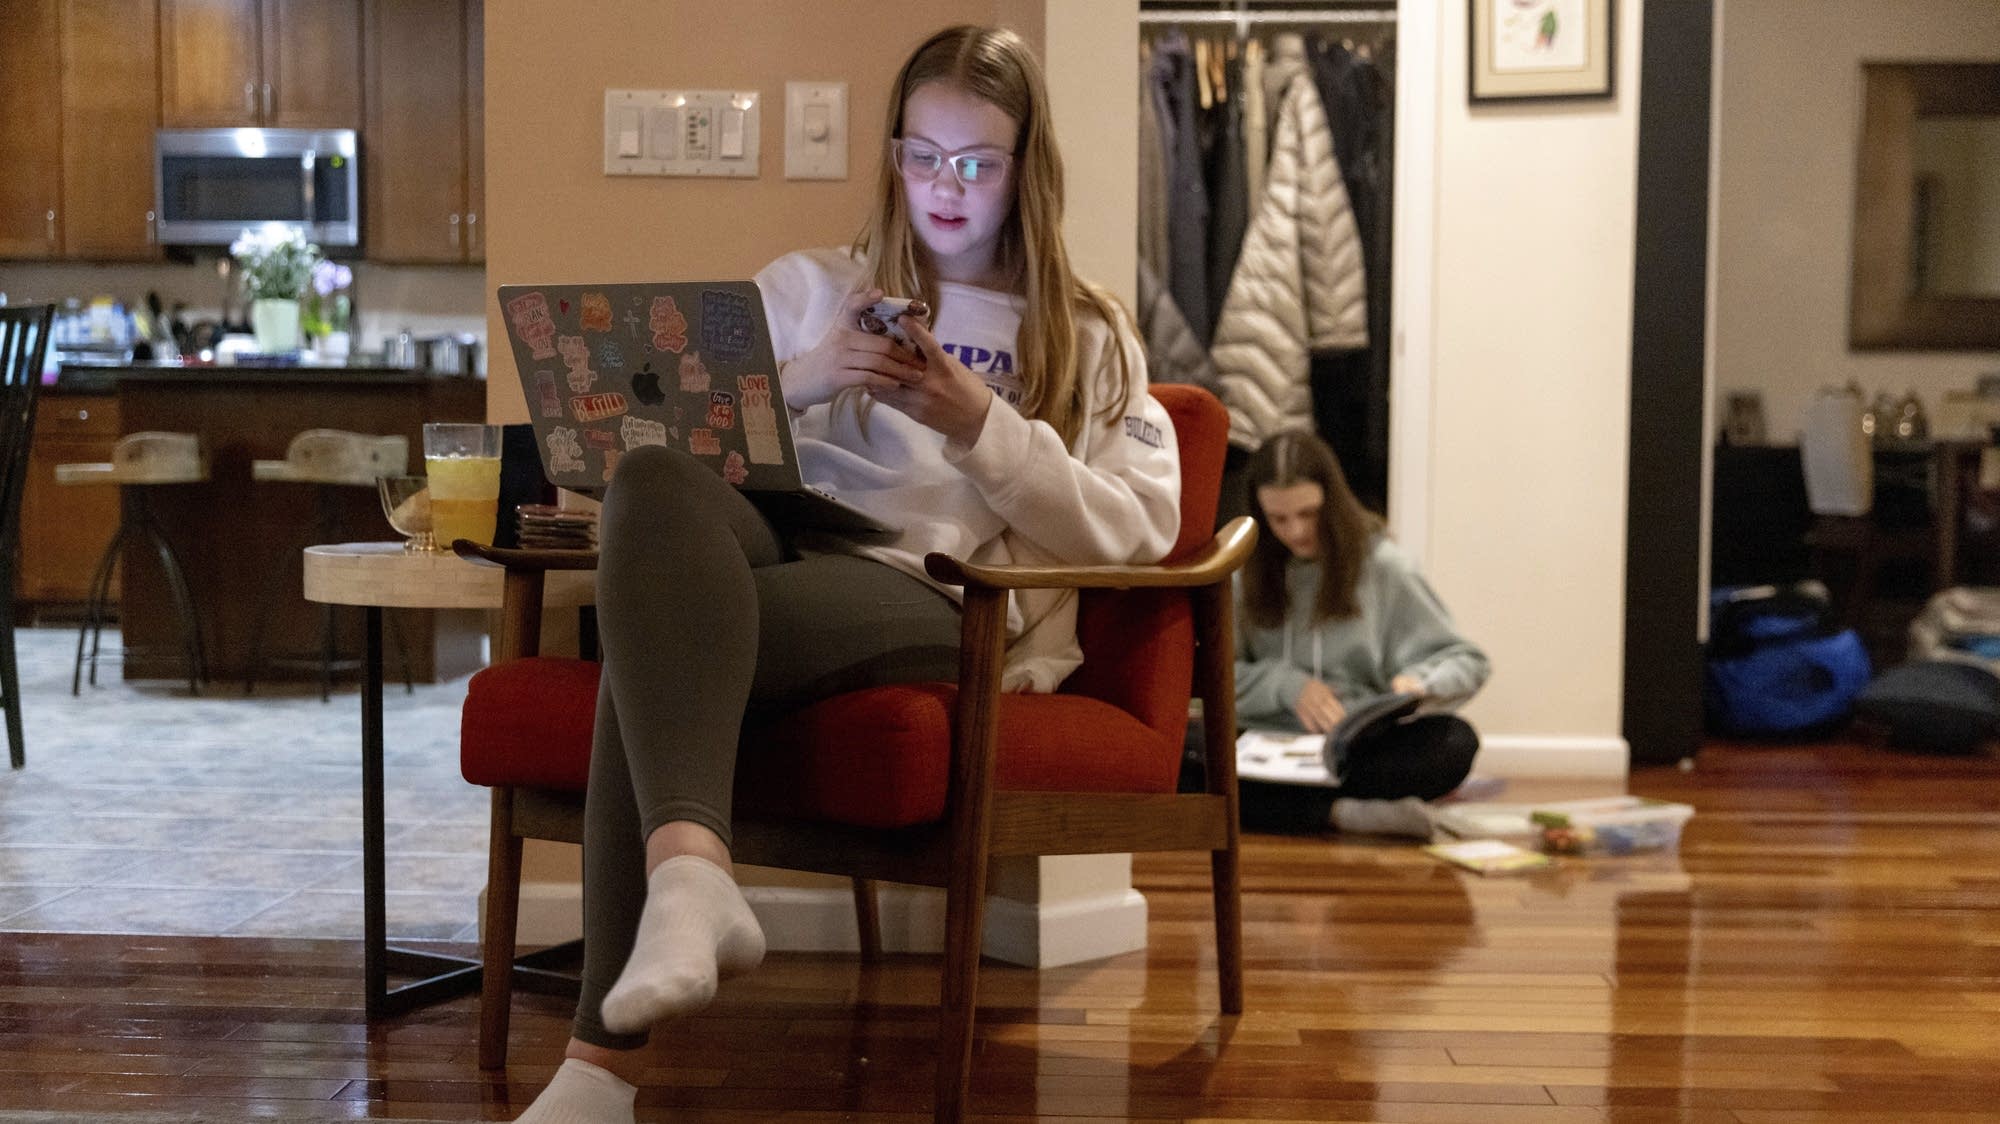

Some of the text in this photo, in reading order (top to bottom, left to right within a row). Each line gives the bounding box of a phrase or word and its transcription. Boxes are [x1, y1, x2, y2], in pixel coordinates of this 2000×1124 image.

[739, 376, 768, 391] LOVE
[743, 392, 770, 408] JOY
[573, 394, 623, 422] BE STILL
[709, 414, 729, 427] GOD
